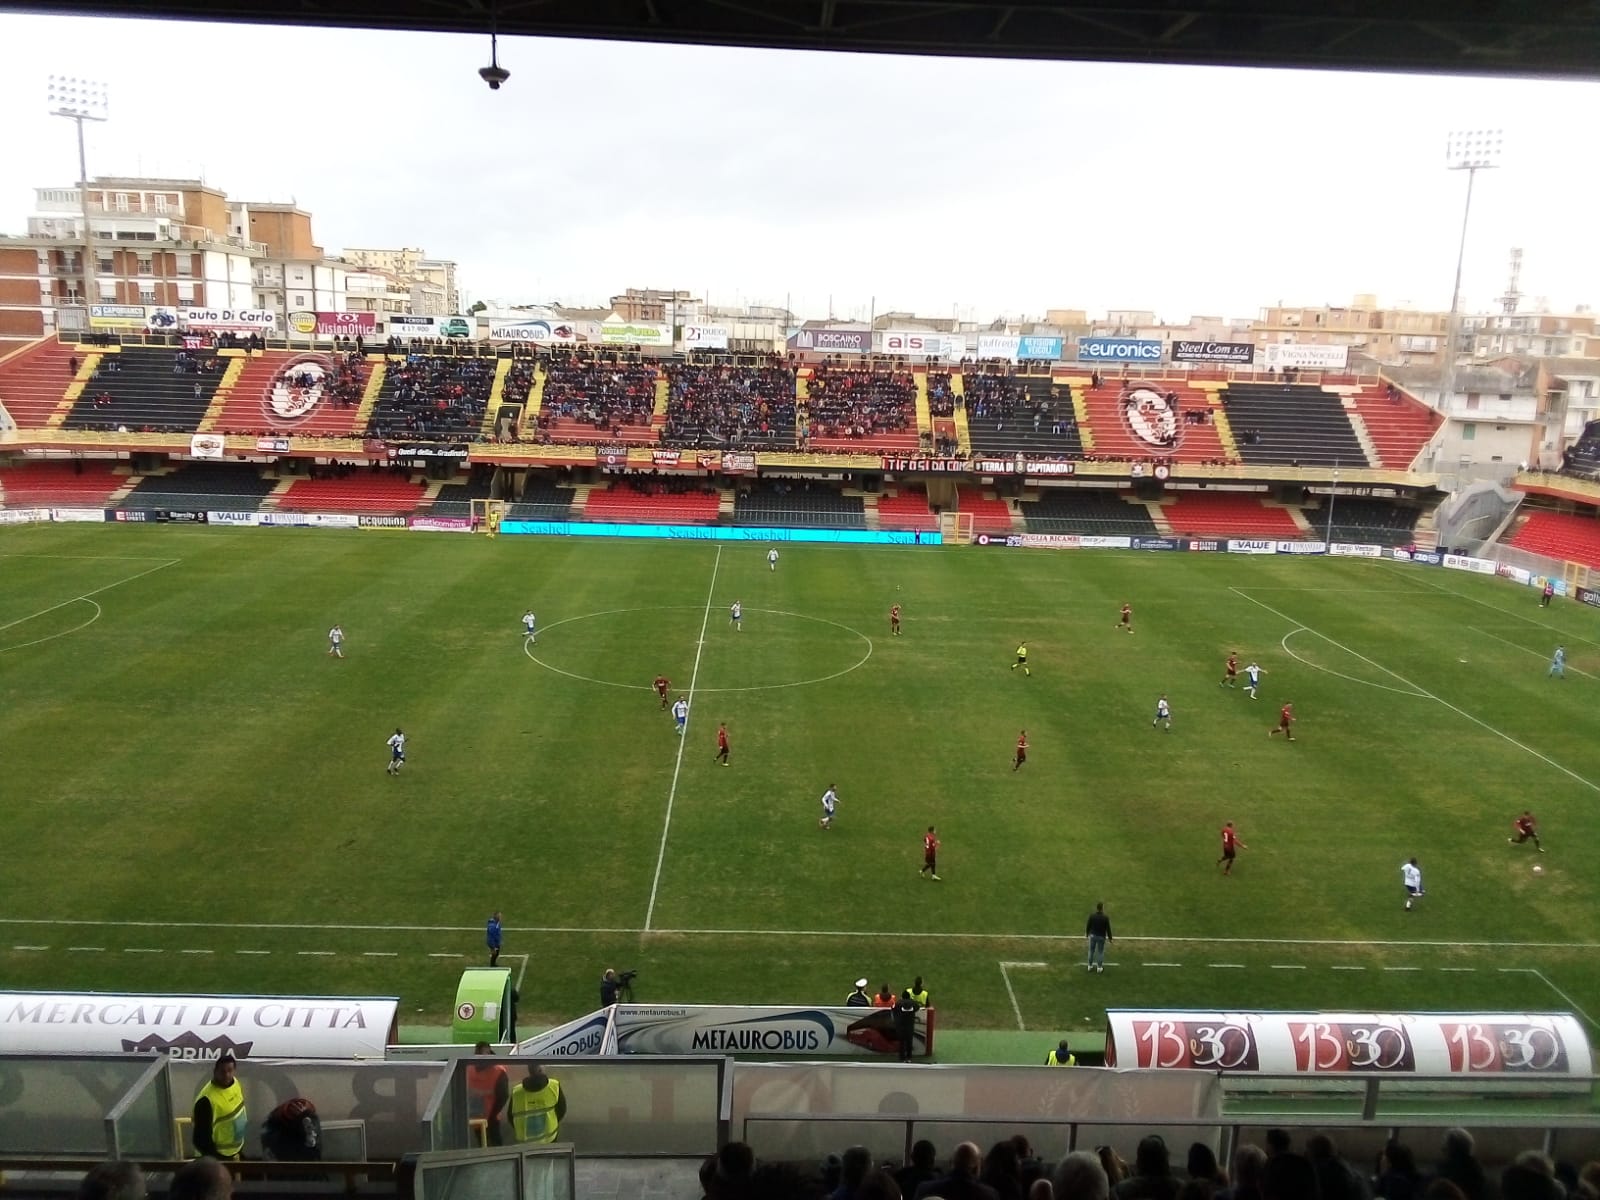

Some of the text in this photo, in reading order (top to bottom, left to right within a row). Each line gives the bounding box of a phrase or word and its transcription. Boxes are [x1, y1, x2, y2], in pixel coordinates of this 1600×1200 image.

[189, 309, 273, 322] auto Di Carlo
[491, 328, 545, 340] METAUROBUS
[818, 334, 861, 343] BOSCAINO
[1088, 341, 1161, 358] euronics
[1177, 341, 1204, 353] Steel
[1206, 342, 1231, 354] Com
[887, 459, 929, 471] TIFOSI
[931, 460, 945, 472] DA
[981, 461, 1069, 473] TERRA DI CAPITANATA
[360, 515, 406, 528] acquolina
[887, 532, 936, 545] Seasell
[5, 1000, 185, 1026] MERCATI
[199, 1004, 240, 1027] DI
[619, 1009, 686, 1017] www.metaurobus.it
[691, 1029, 820, 1051] METAUROBUS
[1142, 1020, 1185, 1070] 13
[169, 1046, 236, 1060] PRIMA
[1299, 1022, 1342, 1073] 13
[1452, 1023, 1496, 1073] 13
